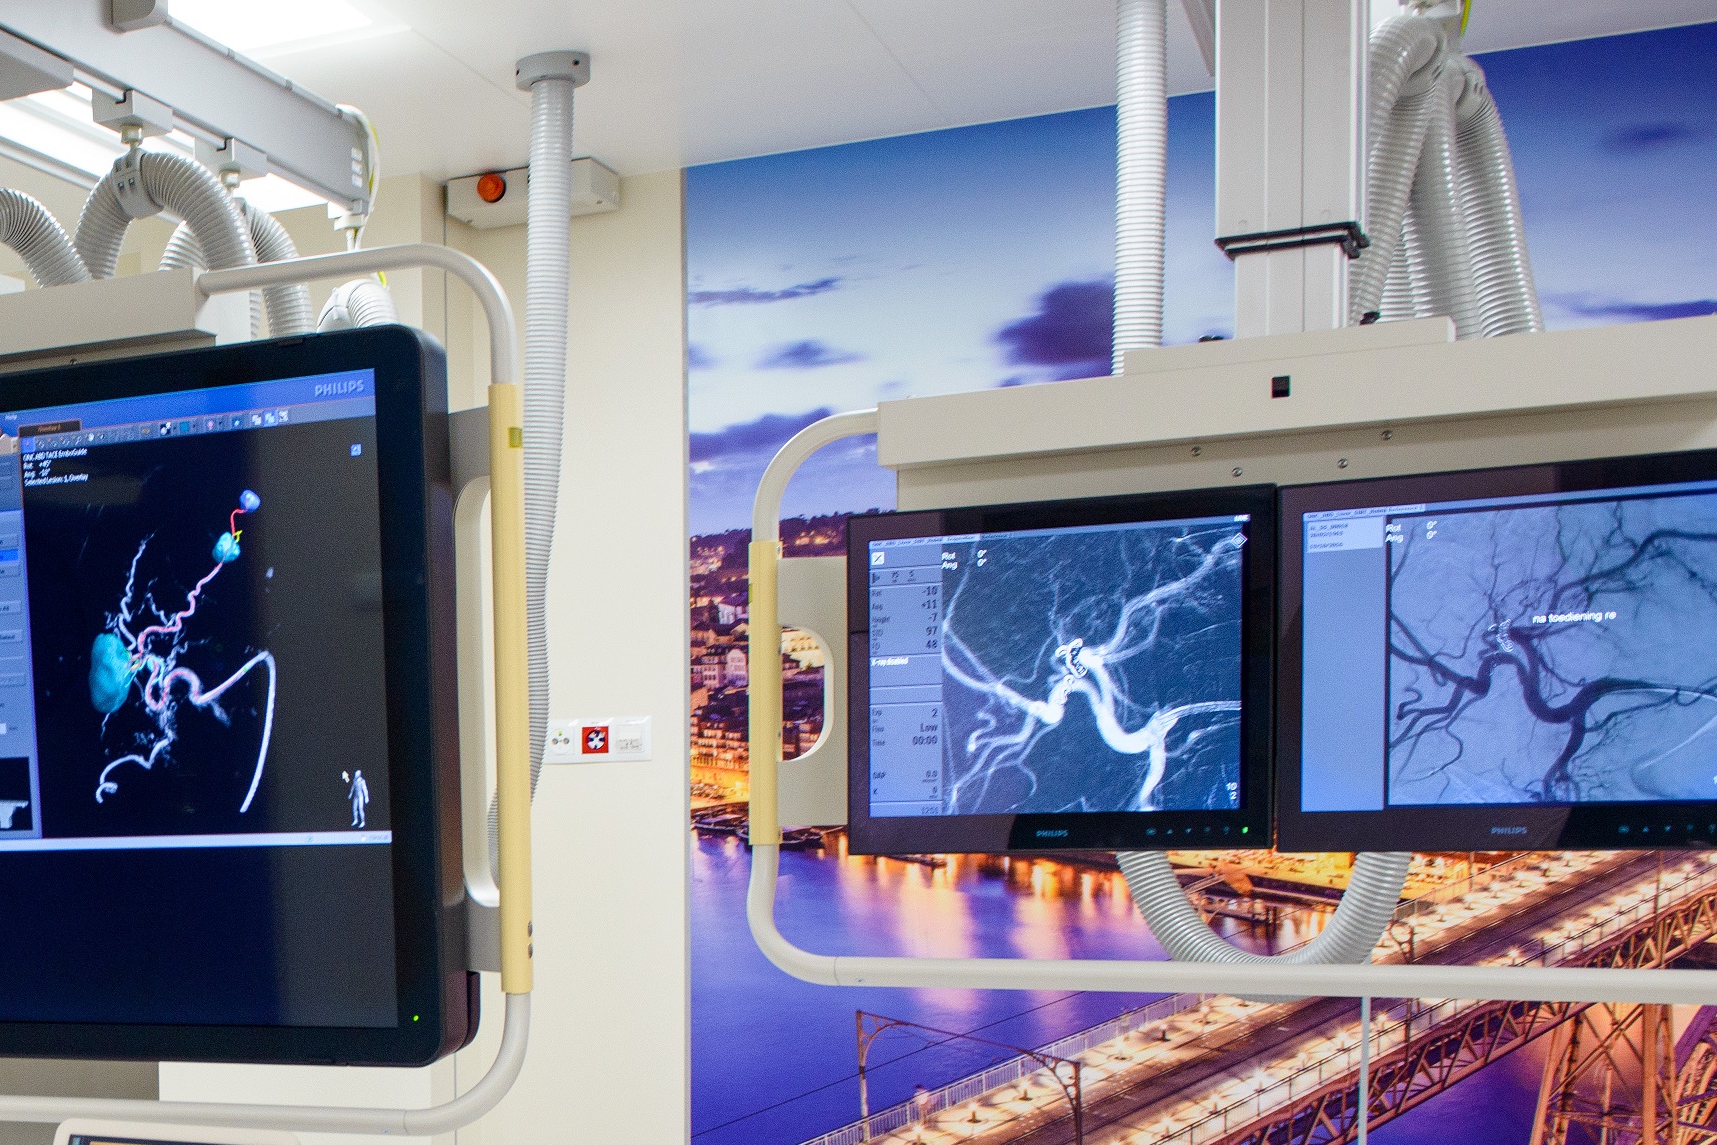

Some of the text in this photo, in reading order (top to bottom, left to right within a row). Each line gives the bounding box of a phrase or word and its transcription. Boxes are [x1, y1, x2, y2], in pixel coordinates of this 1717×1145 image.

[315, 380, 365, 397] PHILIPS
[1385, 523, 1402, 533] Rot
[1385, 533, 1404, 544] Ang
[941, 561, 958, 571] Ang
[1532, 615, 1547, 624] na
[1605, 611, 1617, 620] re
[925, 625, 938, 636] 97
[925, 639, 938, 650] 48
[932, 708, 938, 718] 2
[920, 723, 938, 733] Low
[912, 735, 938, 746] 00:00
[1225, 783, 1238, 791] 10
[1231, 791, 1238, 800] 2
[1036, 829, 1069, 838] PHILIPS
[1490, 826, 1528, 835] PHILIPS
